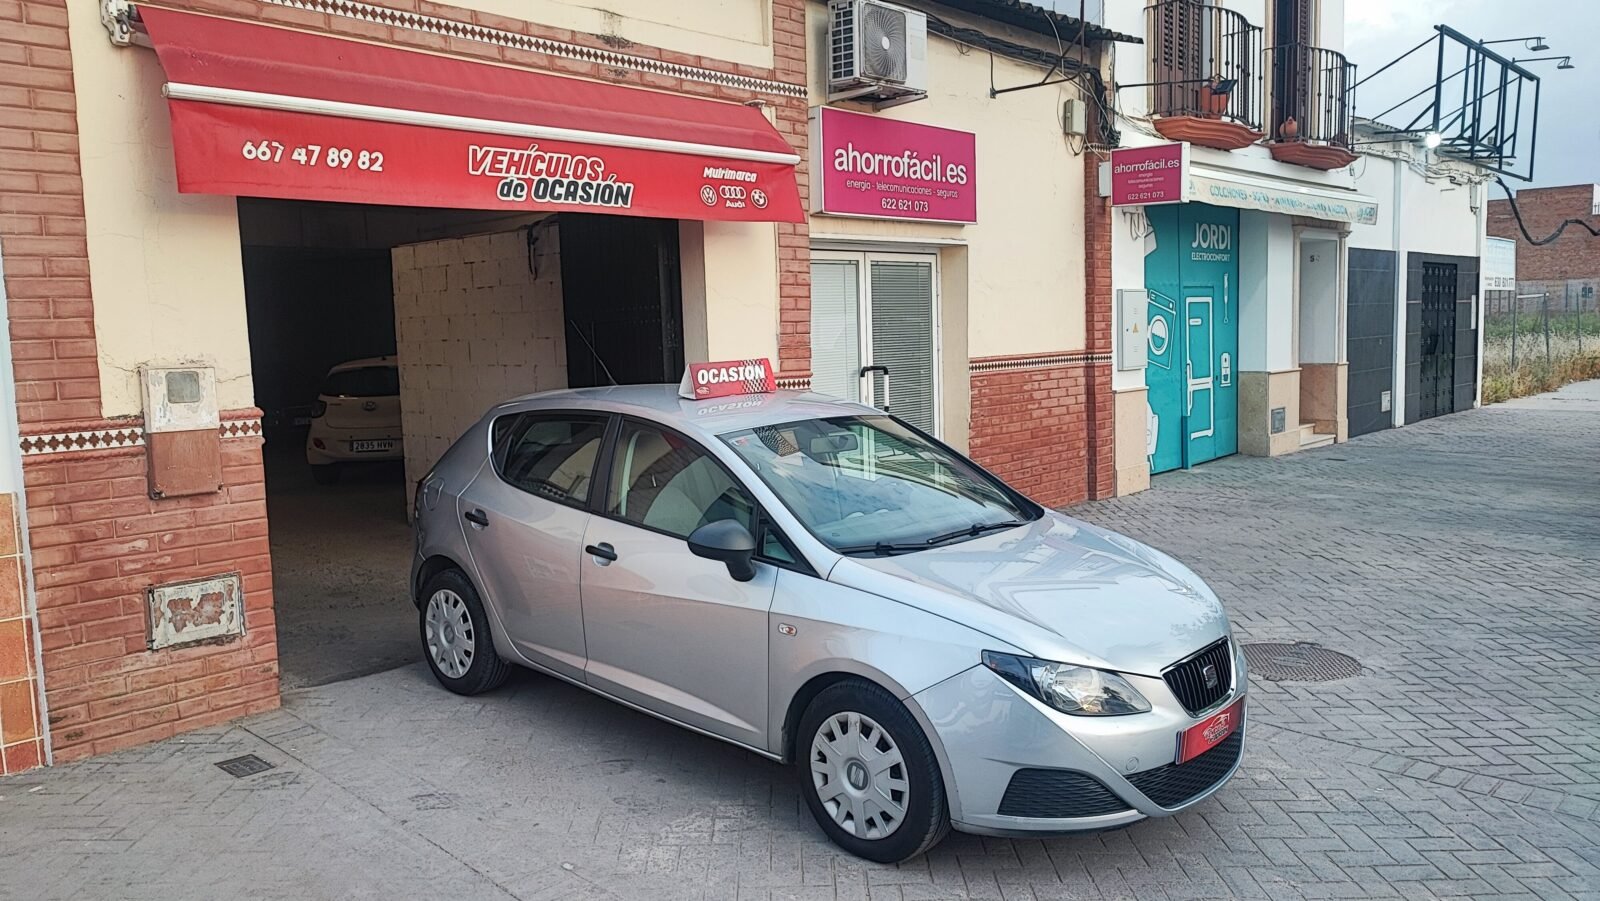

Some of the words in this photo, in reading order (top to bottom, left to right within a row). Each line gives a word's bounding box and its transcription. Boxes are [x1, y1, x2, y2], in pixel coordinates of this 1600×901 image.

[242, 140, 285, 163] 667
[291, 145, 321, 166] 47
[326, 147, 354, 169] 89
[357, 150, 383, 172] 82
[469, 143, 604, 181] VEHÍCULOS
[834, 142, 968, 185] ahorrofácil.es
[1114, 158, 1180, 174] ahorrofácil.es
[497, 174, 526, 201] de
[531, 173, 634, 208] OCASIÓN
[876, 181, 932, 197] telecomunicaciones
[936, 188, 958, 198] seguros
[1140, 192, 1151, 200] 621
[725, 199, 746, 208] Audi
[881, 198, 897, 210] 622
[898, 199, 912, 211] 621
[915, 200, 929, 212] 073
[1192, 222, 1230, 250] JORDI
[1192, 252, 1230, 262] ELECTROCONFORT
[355, 441, 375, 450] 2835
[377, 441, 393, 449] HVN
